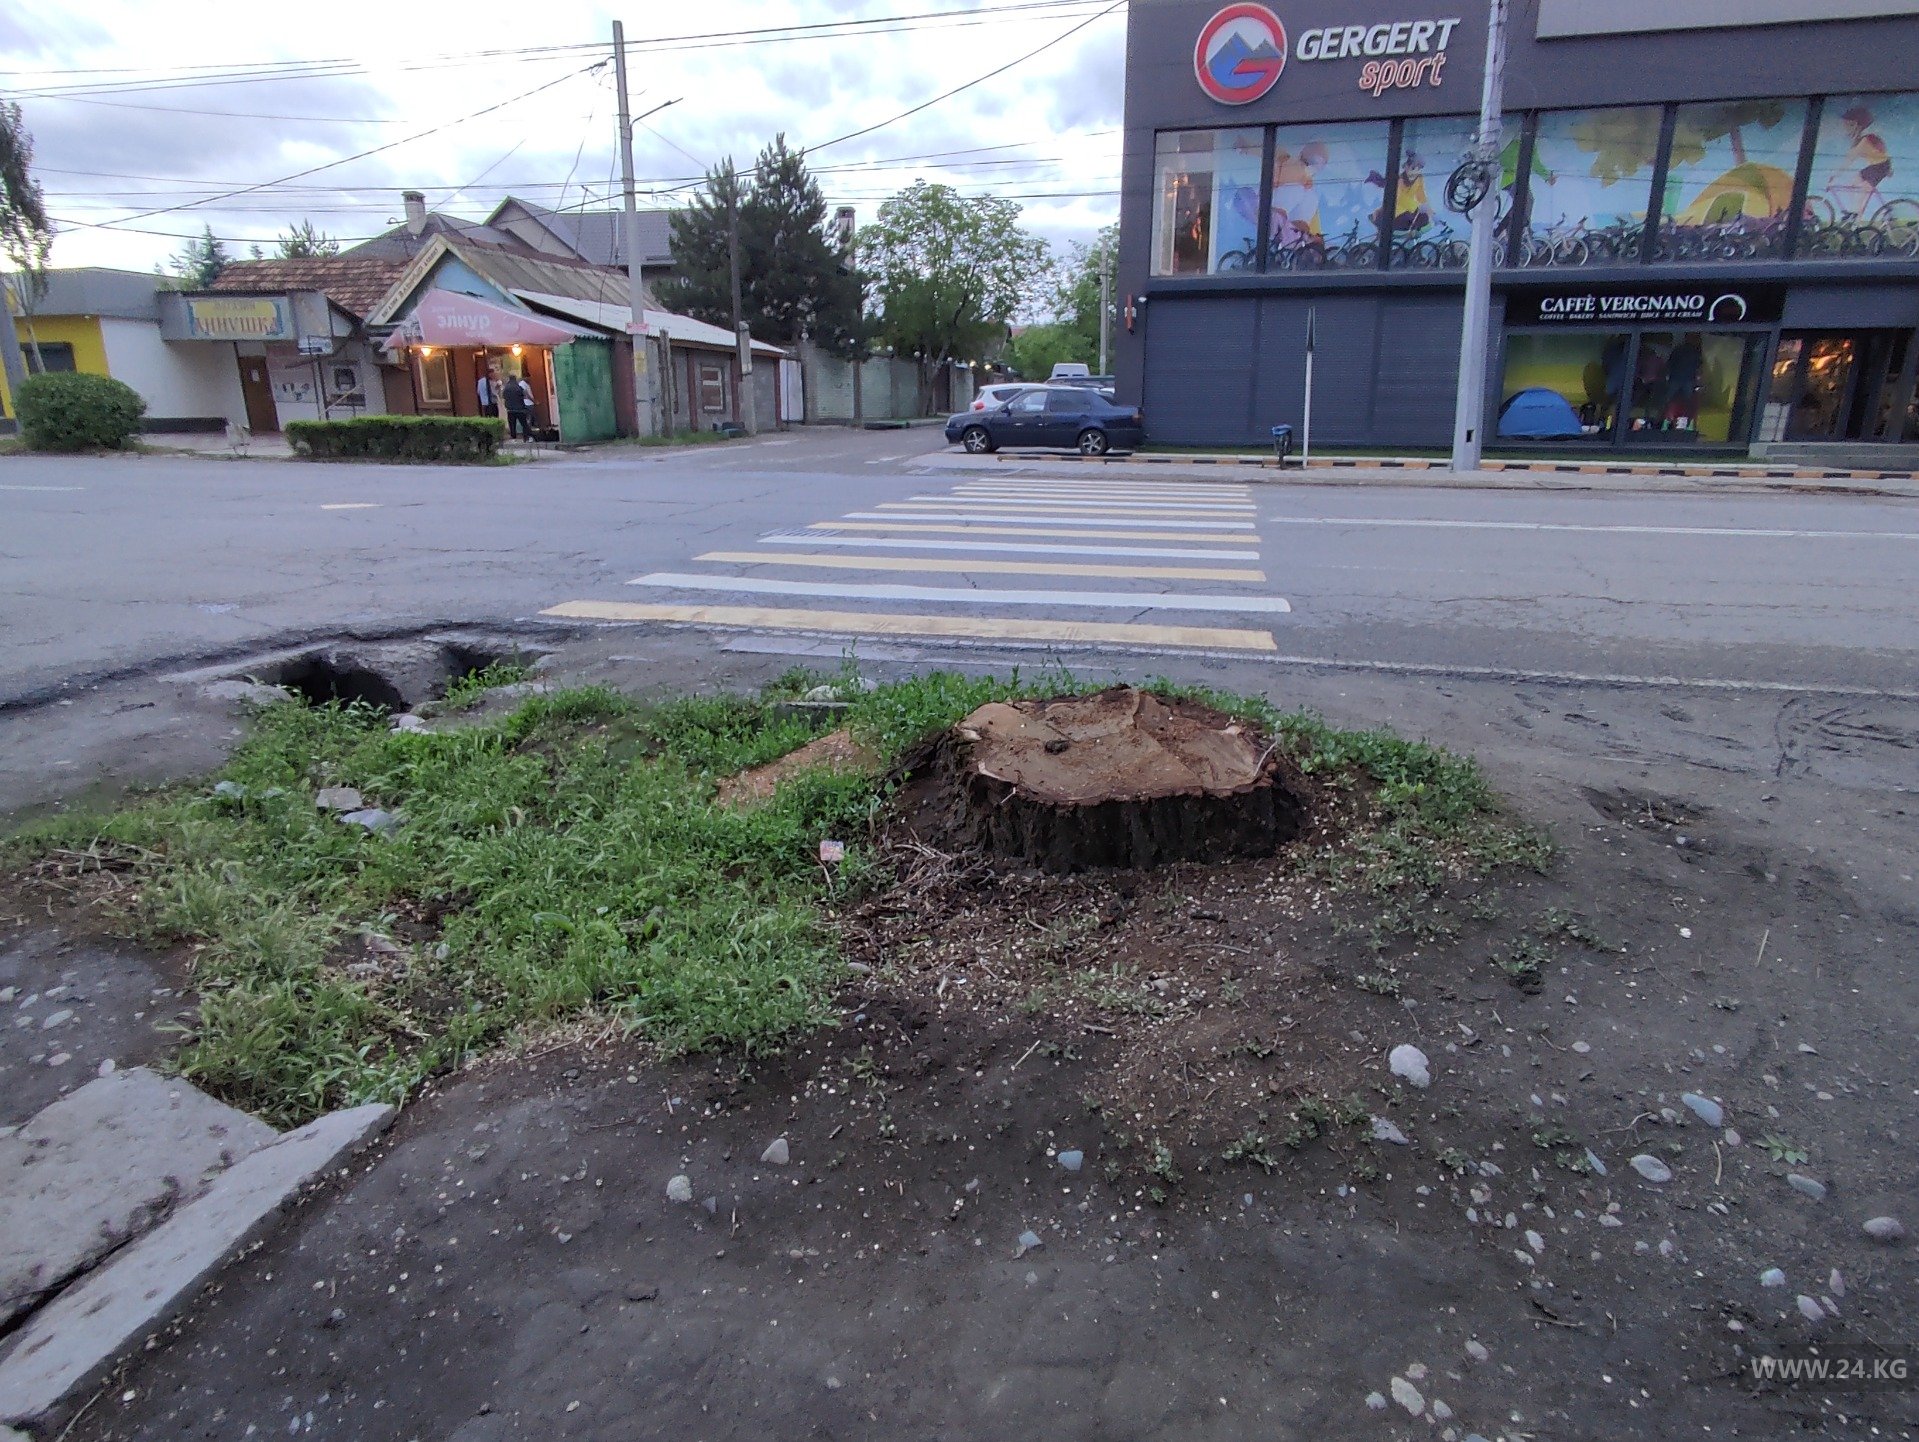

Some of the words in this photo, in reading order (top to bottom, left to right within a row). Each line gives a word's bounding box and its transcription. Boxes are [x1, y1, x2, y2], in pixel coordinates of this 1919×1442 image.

[1296, 18, 1461, 61] GERGERT
[1359, 52, 1447, 98] sport
[1599, 294, 1705, 312] VERGNANO
